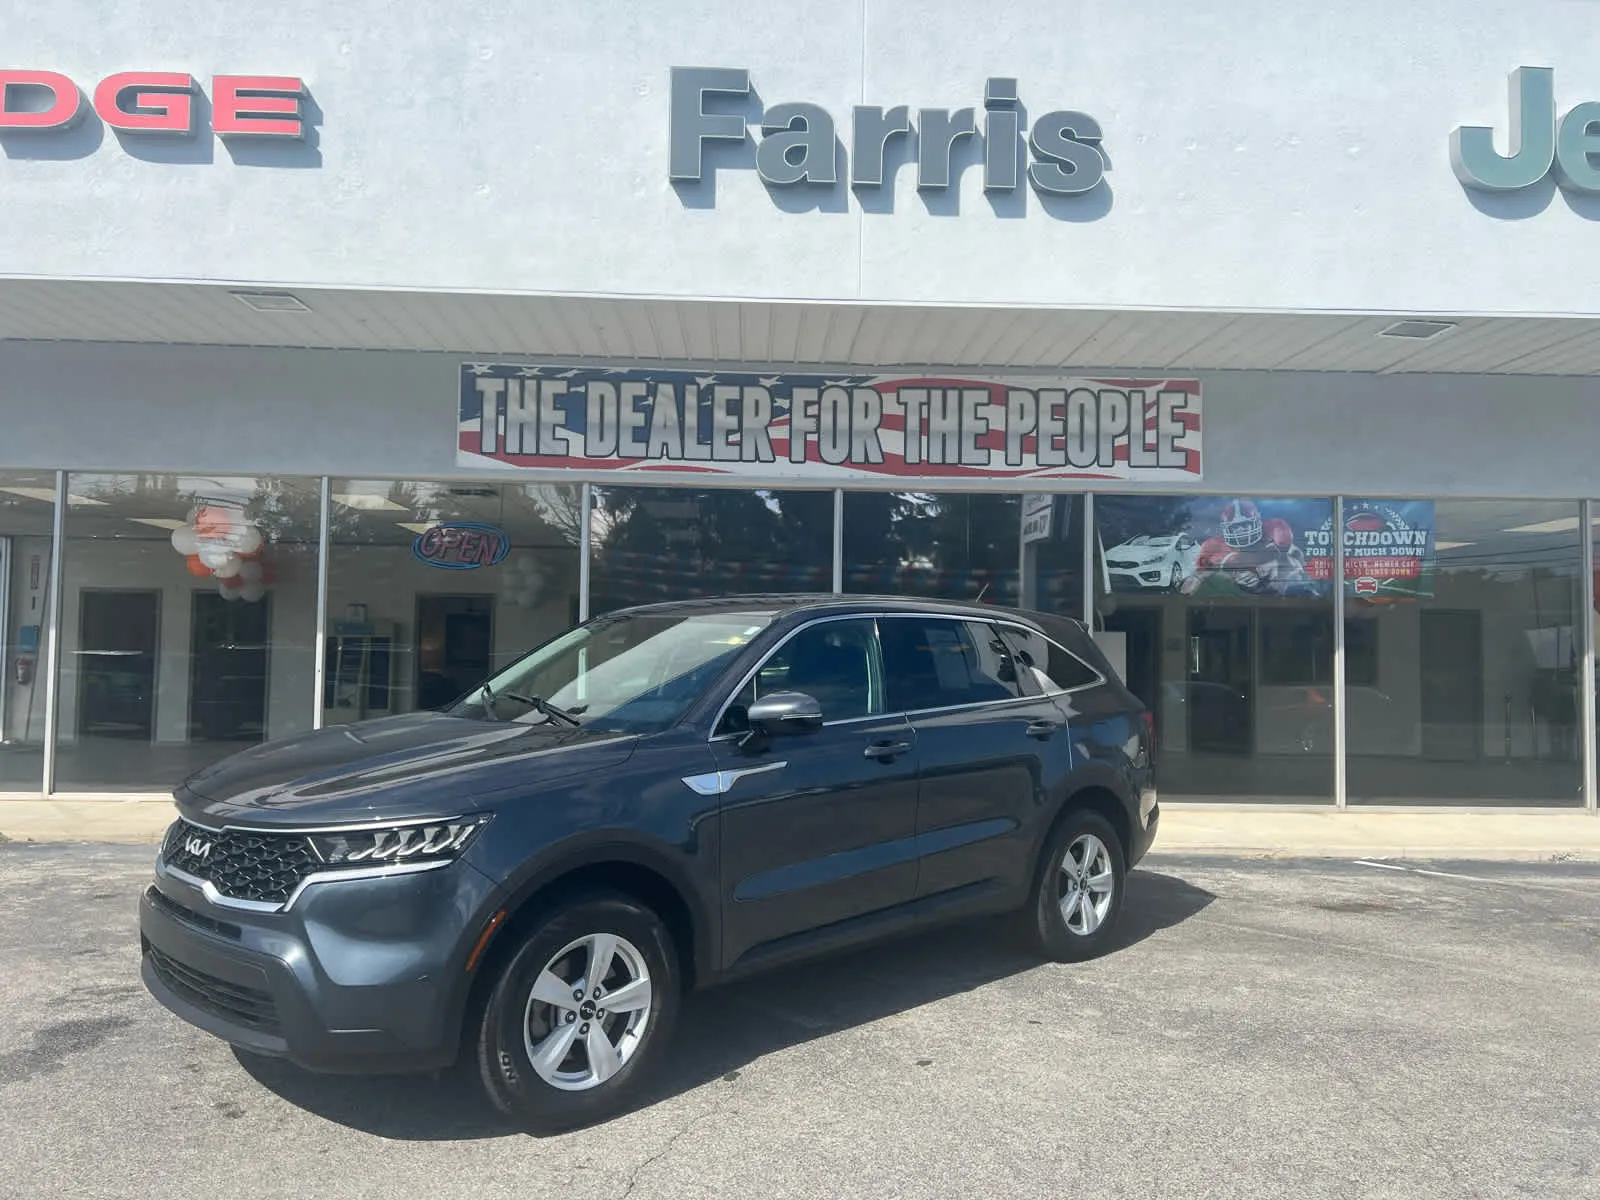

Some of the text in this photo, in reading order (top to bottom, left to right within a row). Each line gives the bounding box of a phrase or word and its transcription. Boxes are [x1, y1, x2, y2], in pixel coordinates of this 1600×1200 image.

[668, 66, 1105, 194] Farris
[474, 376, 1190, 469] THE DEALER FOR THE PEOPLE
[421, 526, 499, 567] OPEN
[1304, 531, 1427, 546] TOCHDOWN
[1305, 547, 1327, 556] FOR
[1354, 547, 1387, 557] MUCH
